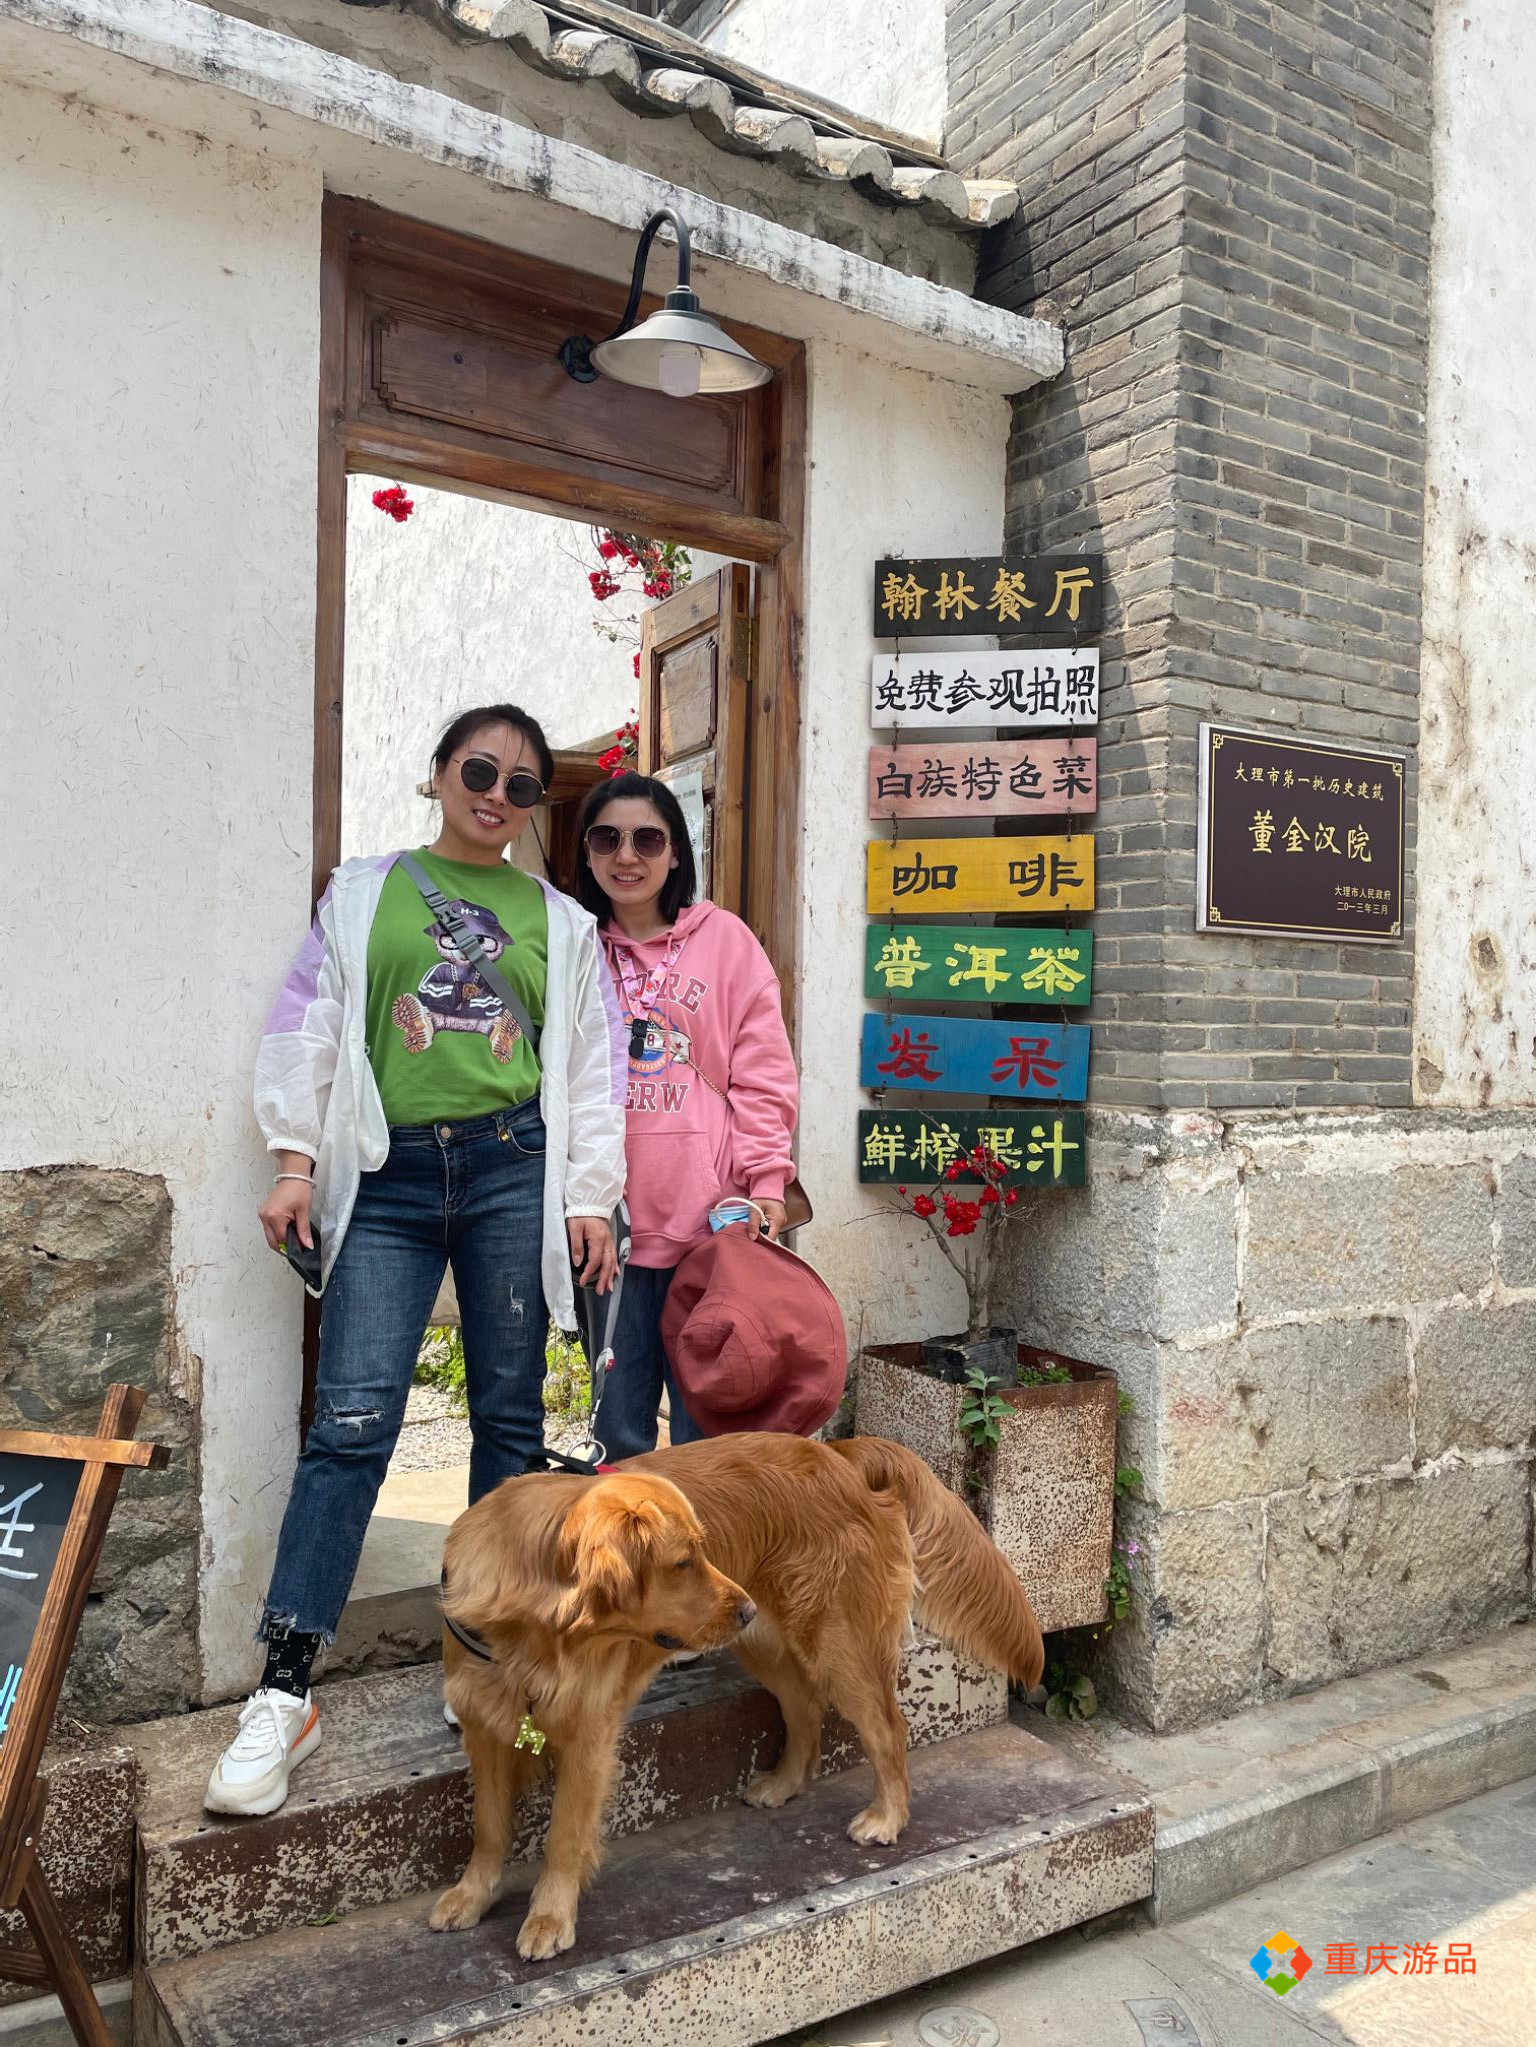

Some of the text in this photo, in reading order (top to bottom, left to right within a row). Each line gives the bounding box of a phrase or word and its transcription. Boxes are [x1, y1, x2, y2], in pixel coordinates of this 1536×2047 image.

[881, 566, 1095, 623] 翰林餐厅
[874, 665, 1097, 716] 免费参观拍照
[876, 755, 1093, 801] 白族特色菜
[1234, 762, 1384, 801] 大理市第一批历史建筑
[1248, 809, 1373, 863] 董金汉院
[892, 852, 1085, 897] 咖啡
[1334, 885, 1391, 900] 大理市人民政府
[874, 935, 1087, 996] 普洱茶
[877, 1027, 1068, 1091] 发呆
